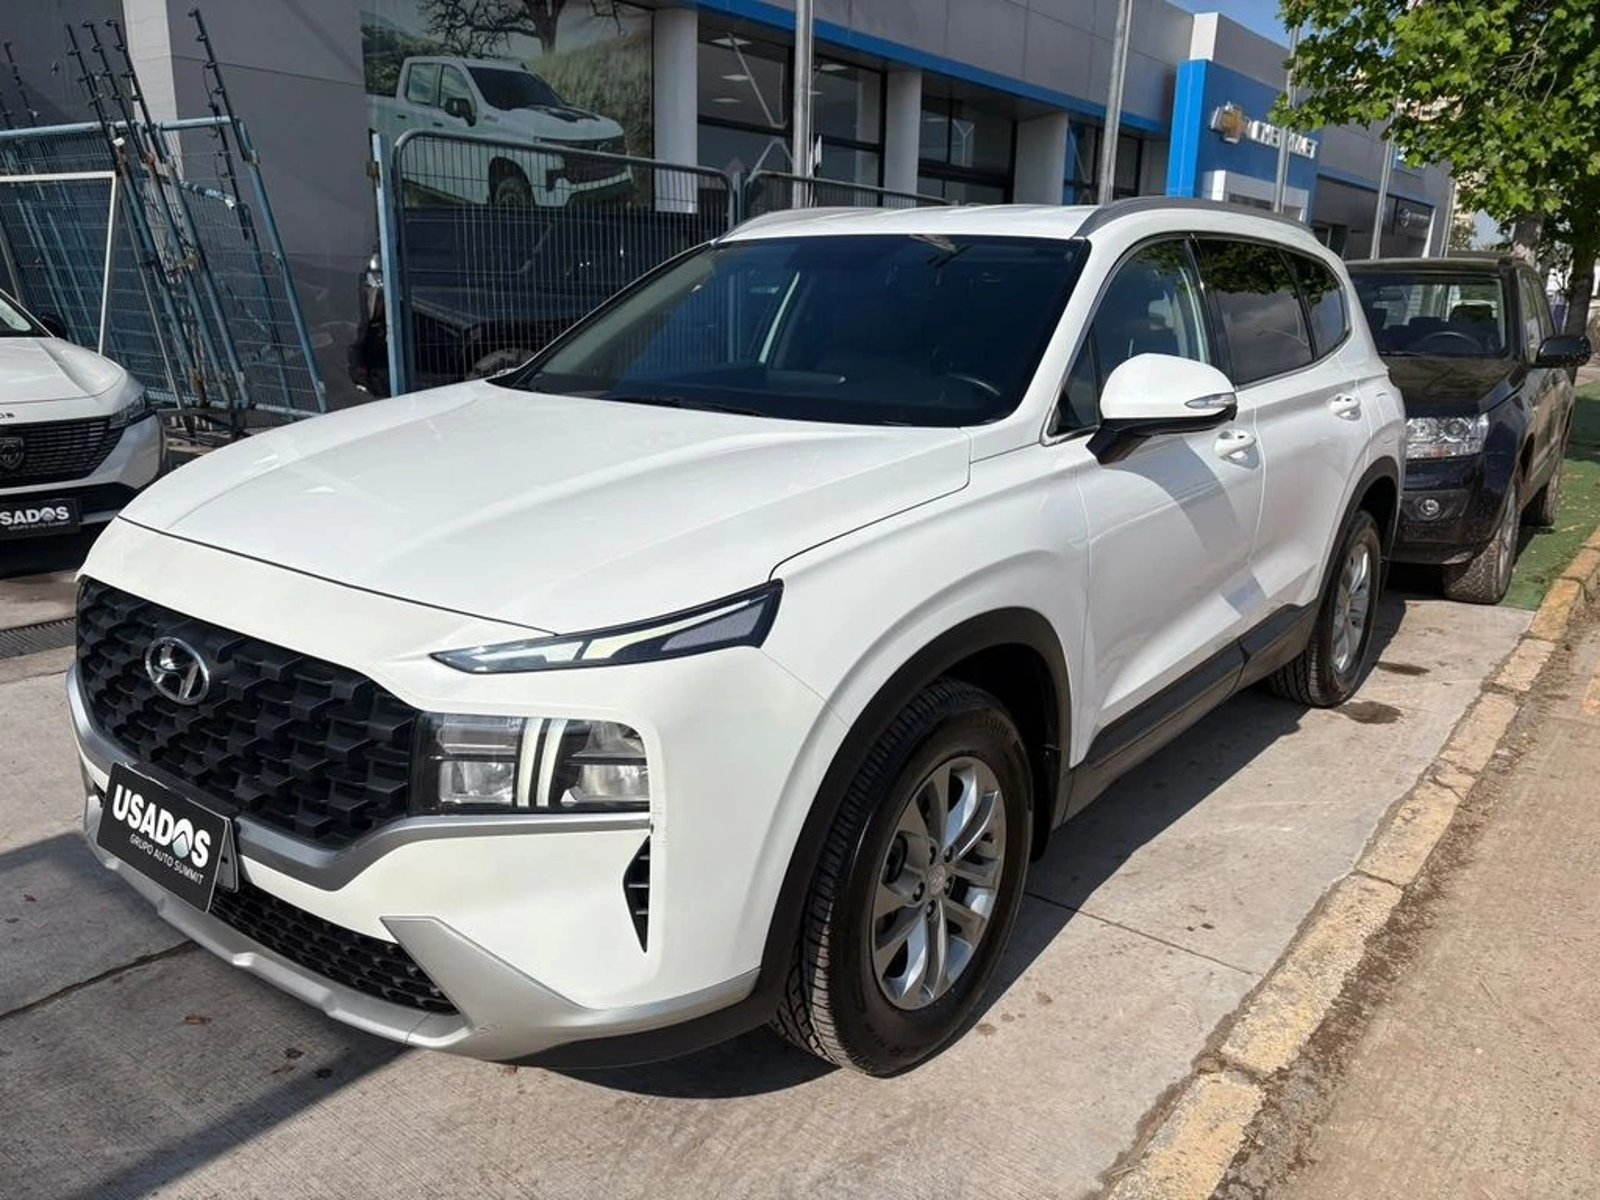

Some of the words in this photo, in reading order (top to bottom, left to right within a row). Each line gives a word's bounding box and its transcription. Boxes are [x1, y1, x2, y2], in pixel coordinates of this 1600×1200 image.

[1250, 119, 1319, 159] CHEOLET
[112, 784, 211, 868] USADOS
[129, 833, 154, 856] GRUPO
[153, 849, 174, 867] AUTO
[173, 860, 204, 885] SUMMIT
